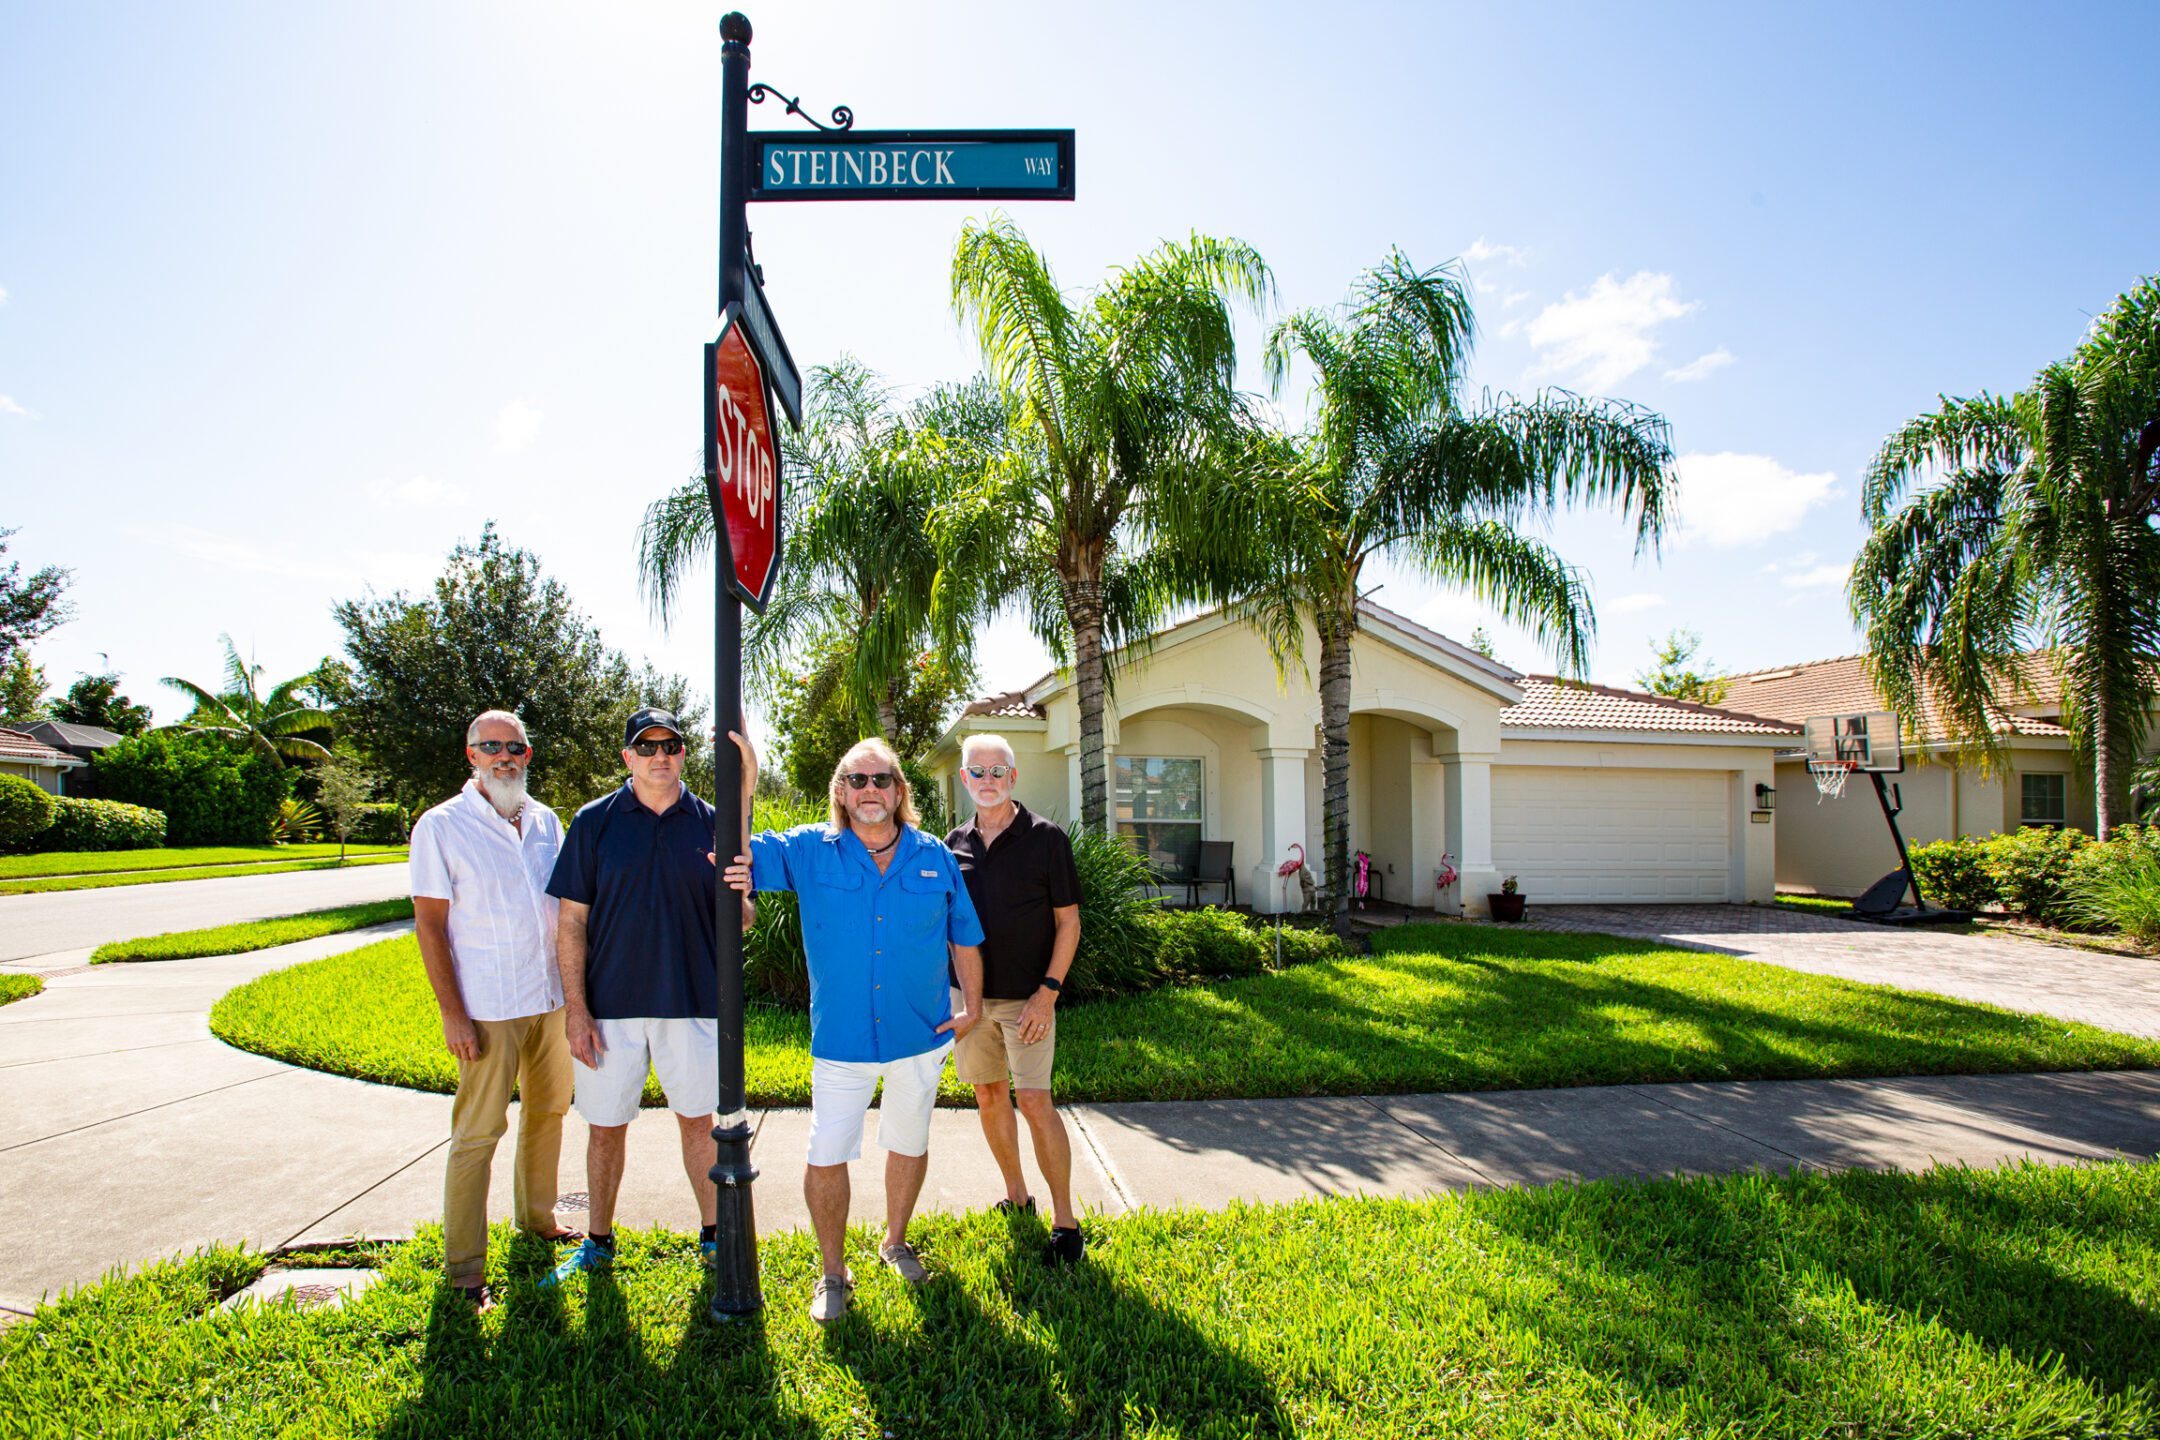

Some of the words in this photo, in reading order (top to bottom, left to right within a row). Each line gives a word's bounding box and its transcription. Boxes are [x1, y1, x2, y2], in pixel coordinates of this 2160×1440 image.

[769, 149, 956, 186] STEINBECK
[1024, 156, 1054, 177] WAY
[717, 383, 772, 530] STOP
